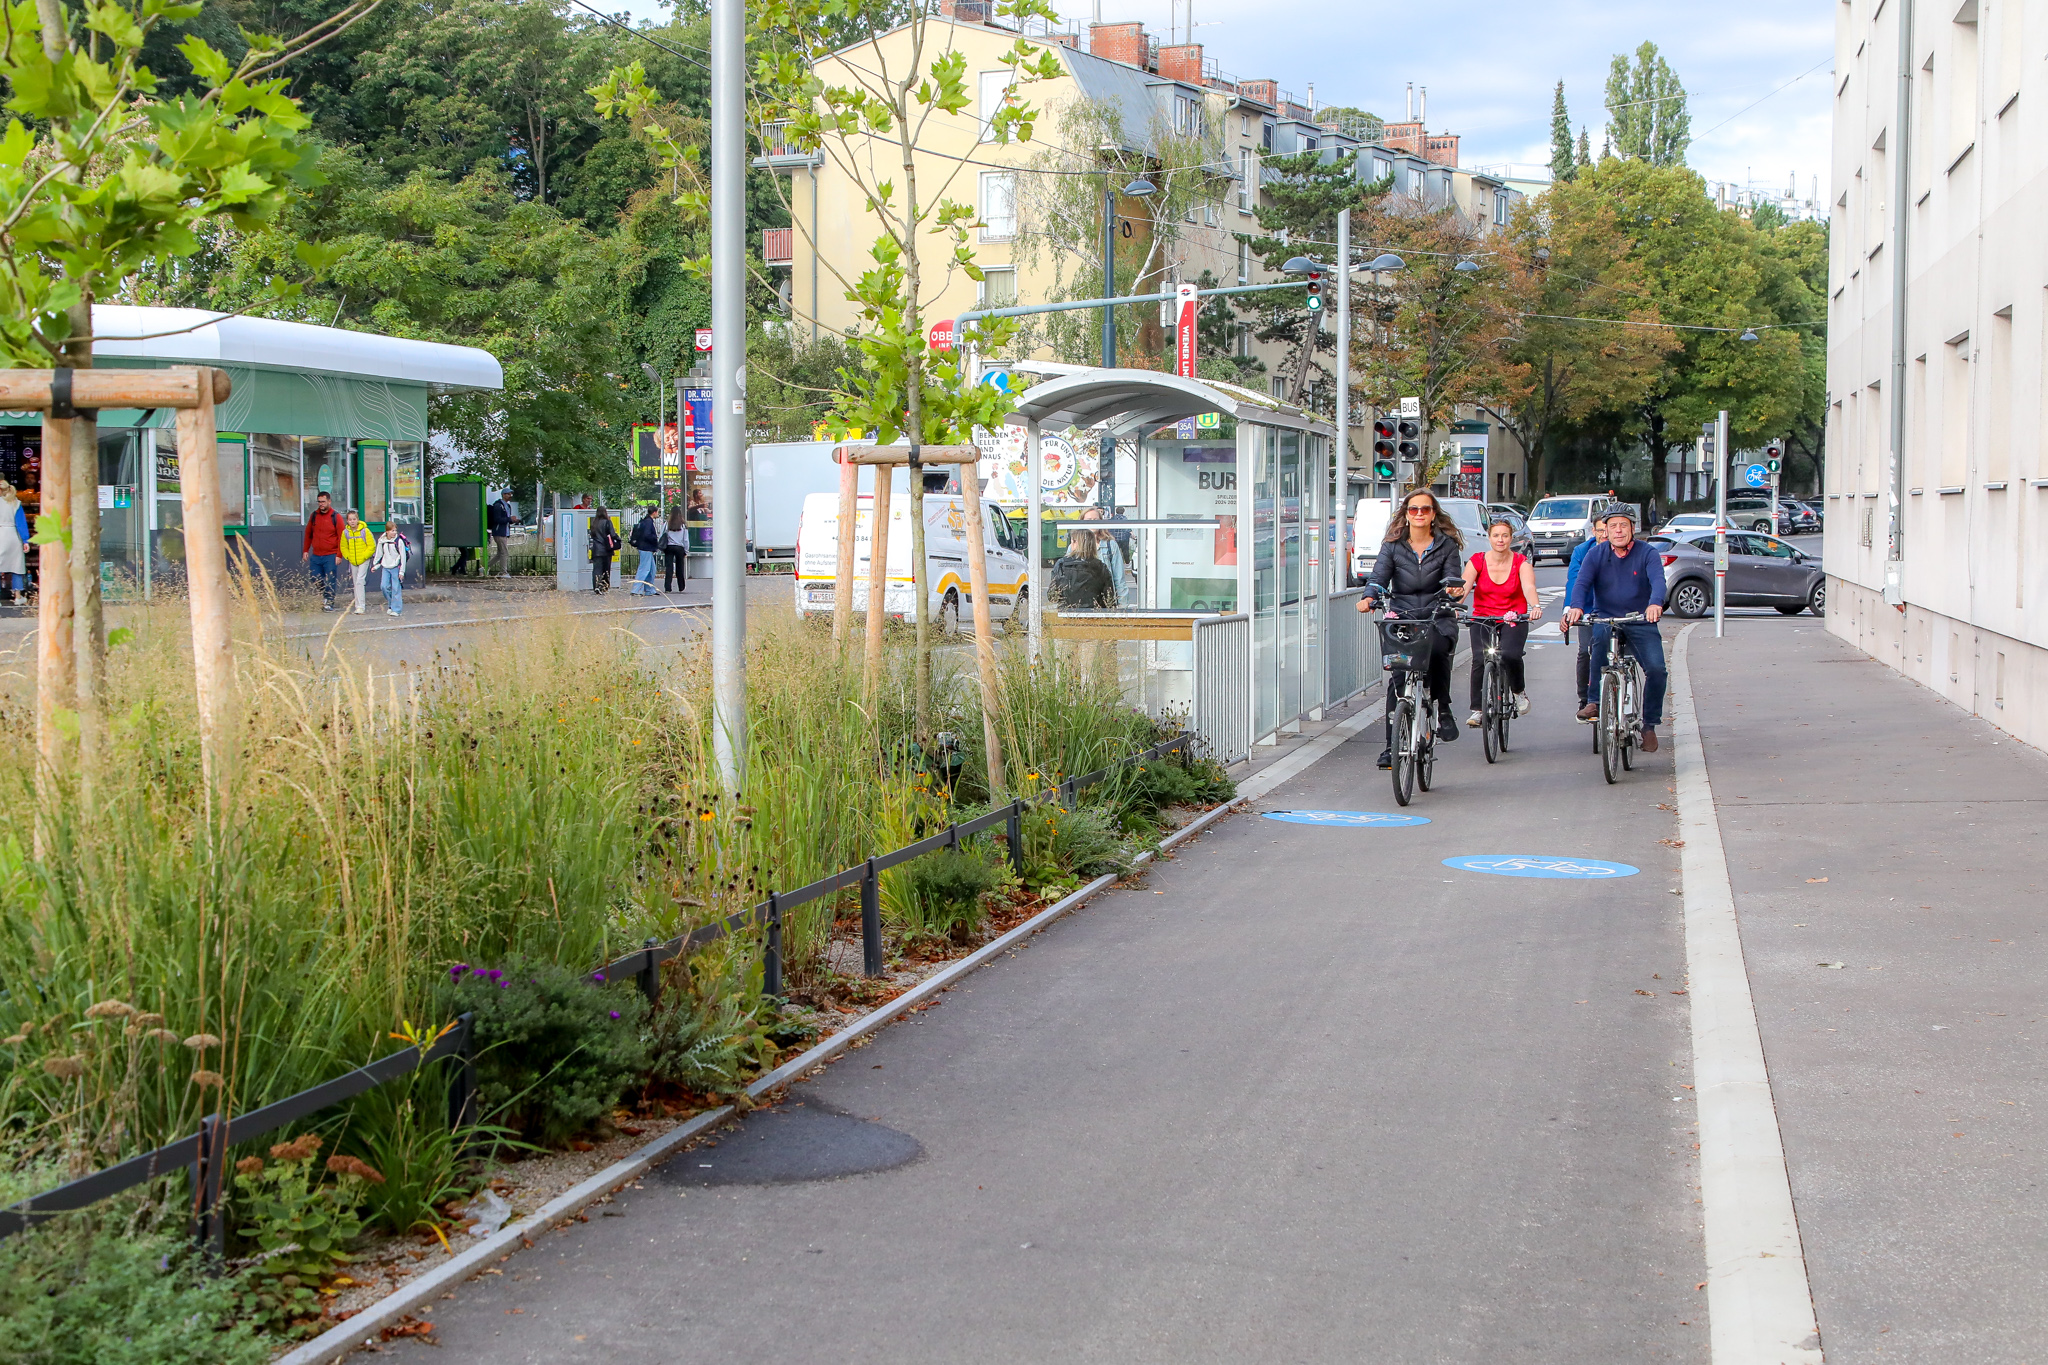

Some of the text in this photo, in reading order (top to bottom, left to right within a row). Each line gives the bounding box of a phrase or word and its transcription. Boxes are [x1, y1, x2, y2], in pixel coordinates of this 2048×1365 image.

[1182, 325, 1190, 360] WIENER
[1402, 401, 1418, 412] BUS
[1060, 444, 1072, 458] UNS
[1056, 464, 1073, 485] NATUR
